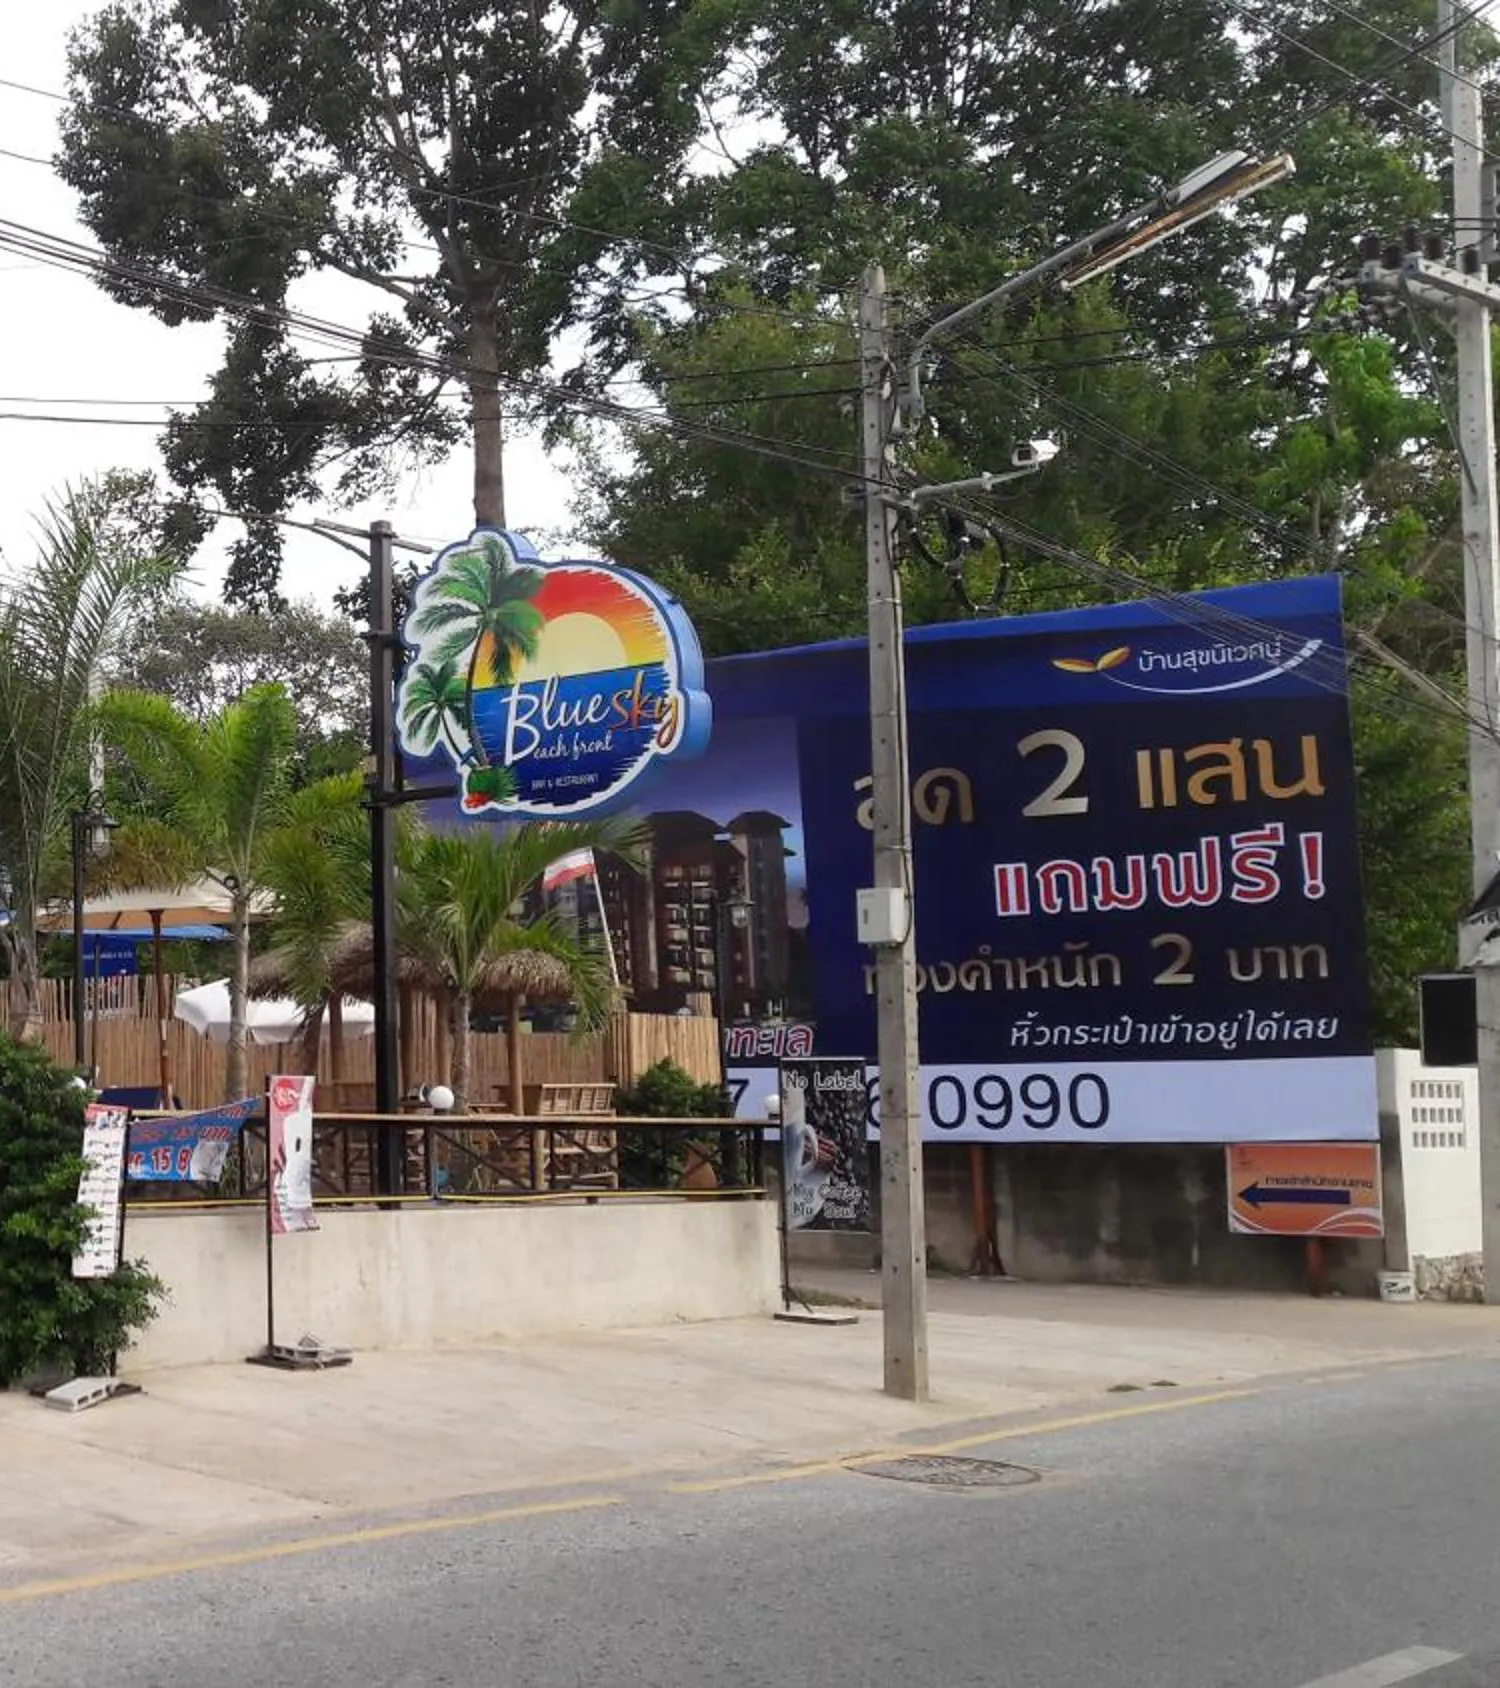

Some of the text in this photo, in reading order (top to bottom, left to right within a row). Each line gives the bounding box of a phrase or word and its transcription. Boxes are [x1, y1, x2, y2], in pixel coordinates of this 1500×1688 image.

[1016, 729, 1089, 817] 2
[1136, 735, 1326, 809] แสน
[1152, 933, 1195, 986] 2
[1227, 943, 1329, 983] บาท
[928, 1072, 1110, 1130] 0990
